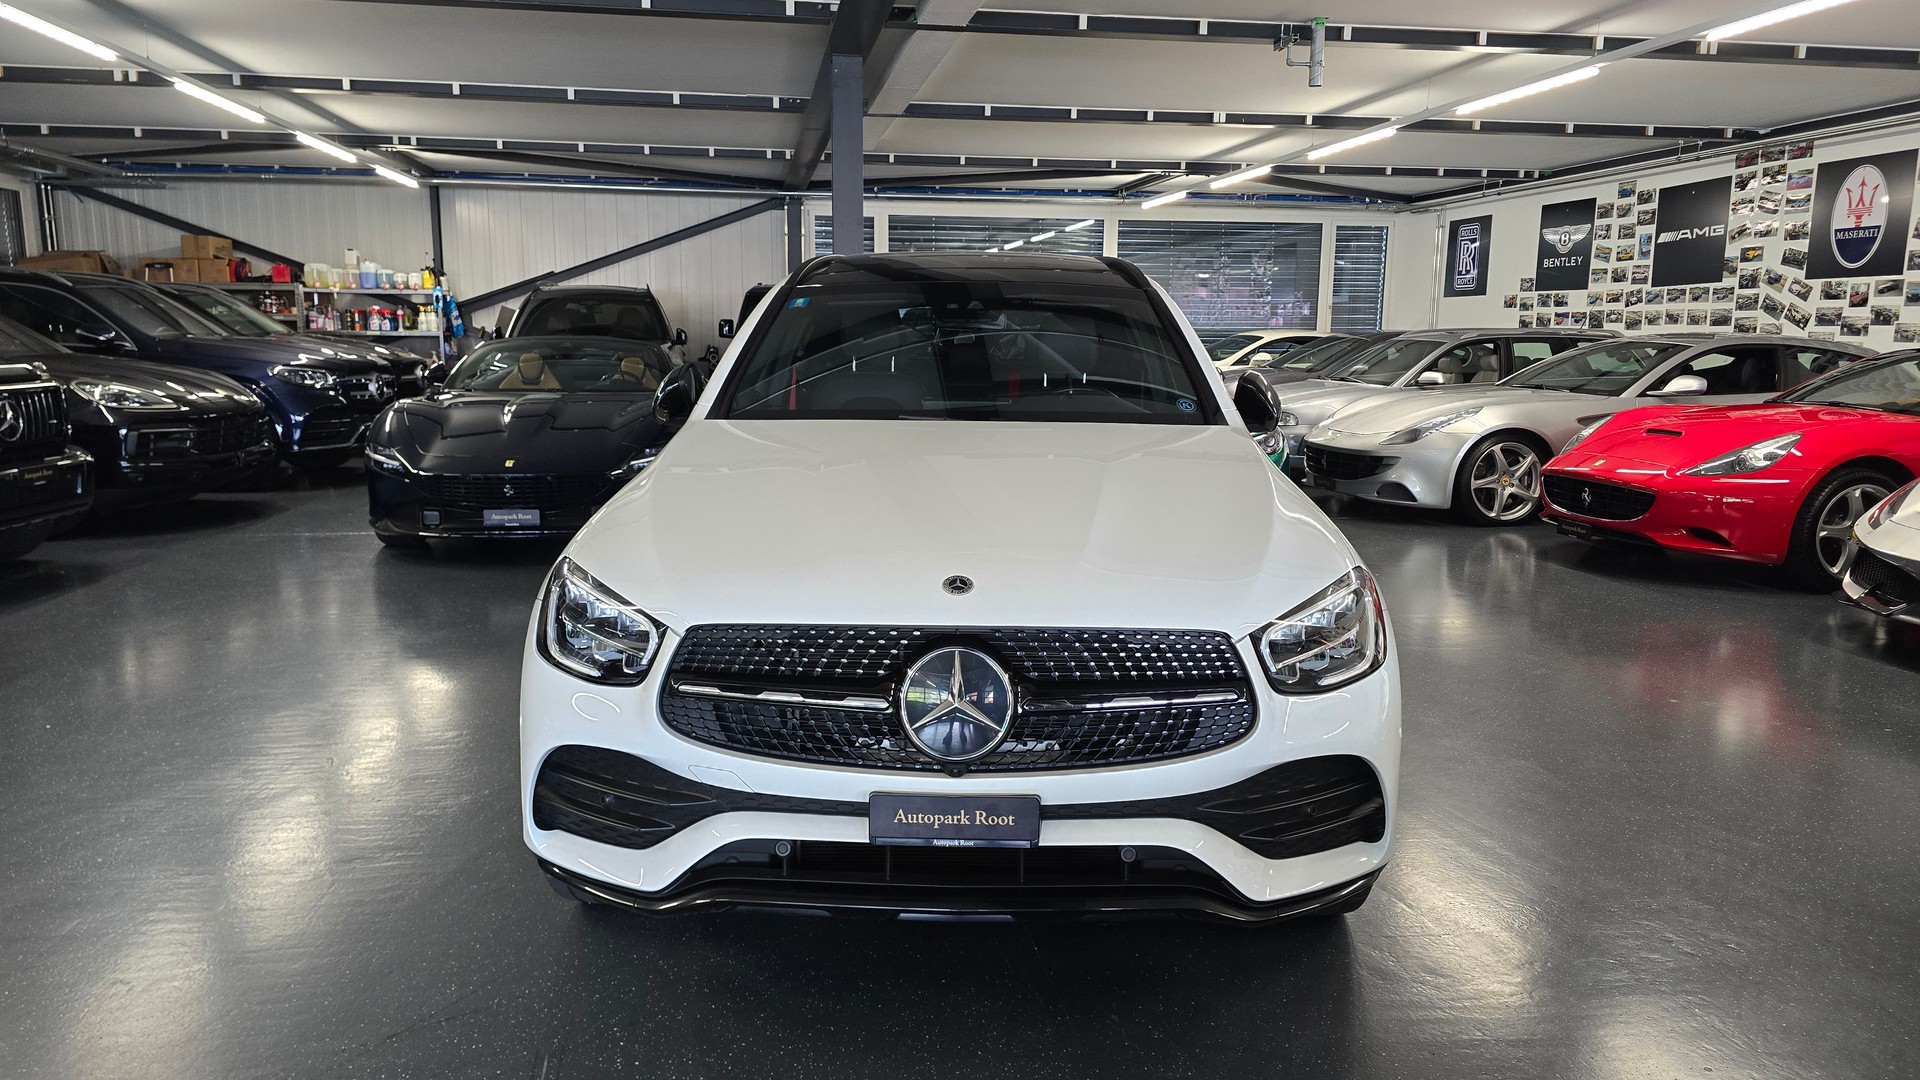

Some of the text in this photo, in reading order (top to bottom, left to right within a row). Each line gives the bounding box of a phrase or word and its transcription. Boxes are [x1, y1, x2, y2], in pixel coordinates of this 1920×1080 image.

[1461, 228, 1477, 236] ROLLS
[1676, 224, 1725, 241] AMG
[1836, 229, 1878, 239] MASERATI
[1543, 256, 1583, 267] BENTLEY
[491, 513, 517, 521] Autopark
[893, 808, 1015, 828] Autopark Root
[932, 839, 959, 847] Autopark
